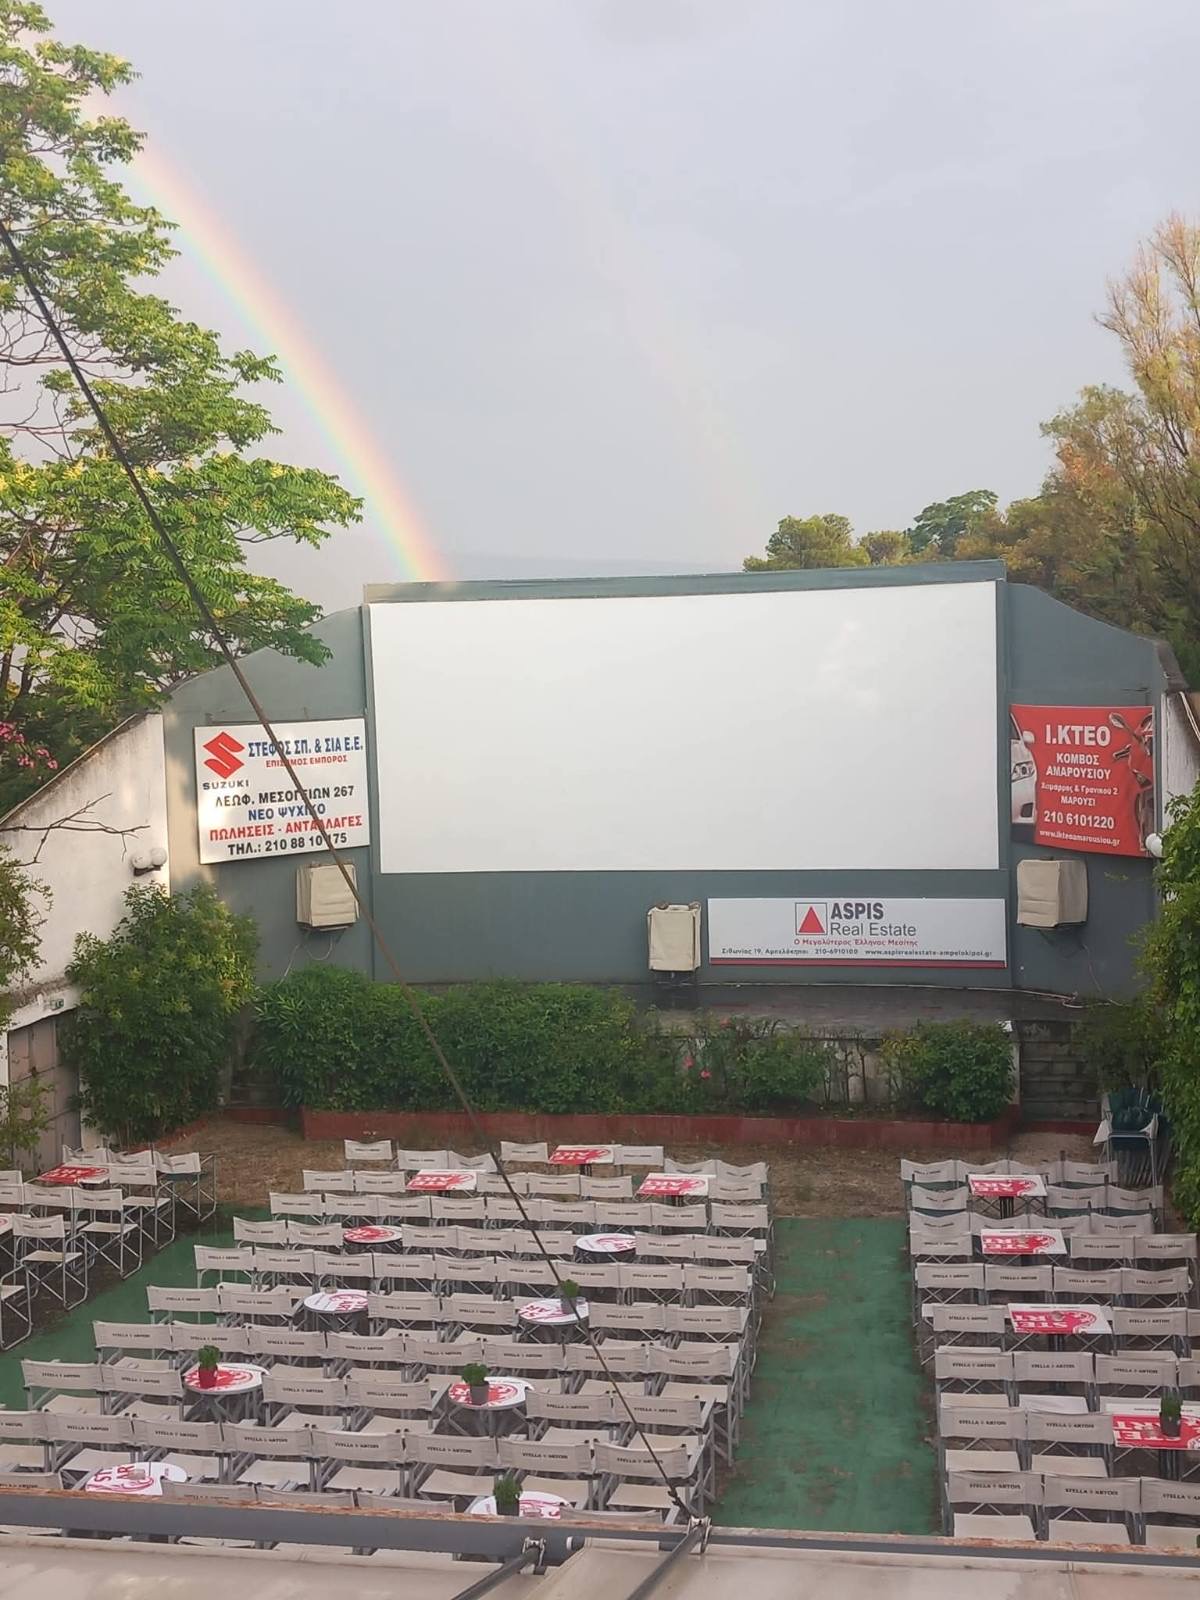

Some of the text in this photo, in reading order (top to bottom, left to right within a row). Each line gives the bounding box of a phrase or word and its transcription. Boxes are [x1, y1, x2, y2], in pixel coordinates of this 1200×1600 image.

[1045, 724, 1111, 747] Ι.ΚΤΕΟ
[314, 738, 322, 753] &
[324, 737, 341, 752] ΣΙΑ
[344, 736, 363, 751] Ε.Ε.
[309, 755, 347, 765] ΕΜΠΟΡΟΣ
[1056, 752, 1100, 766] ΚΟΜΒΟΣ
[1045, 766, 1112, 780] ΑΜΑΡΟΥΣΙΟΥ
[202, 780, 249, 790] SUZUKI
[1074, 784, 1080, 792] &
[1113, 787, 1118, 795] 2
[215, 794, 255, 807] ΛΕΩΦ.
[333, 785, 354, 798] 267
[1060, 795, 1096, 806] ΜΑΡΟΥΣΙ
[248, 808, 274, 821] ΝΕΟ
[1044, 810, 1115, 829] 210 6101220
[209, 824, 275, 841] ΠΩΛΗΣΕΙΣ
[228, 842, 261, 856] ΤΗΛ.:
[264, 838, 287, 852] 210
[290, 837, 305, 849] 88
[830, 902, 884, 920] ASPIS
[830, 922, 917, 937] Real Estate
